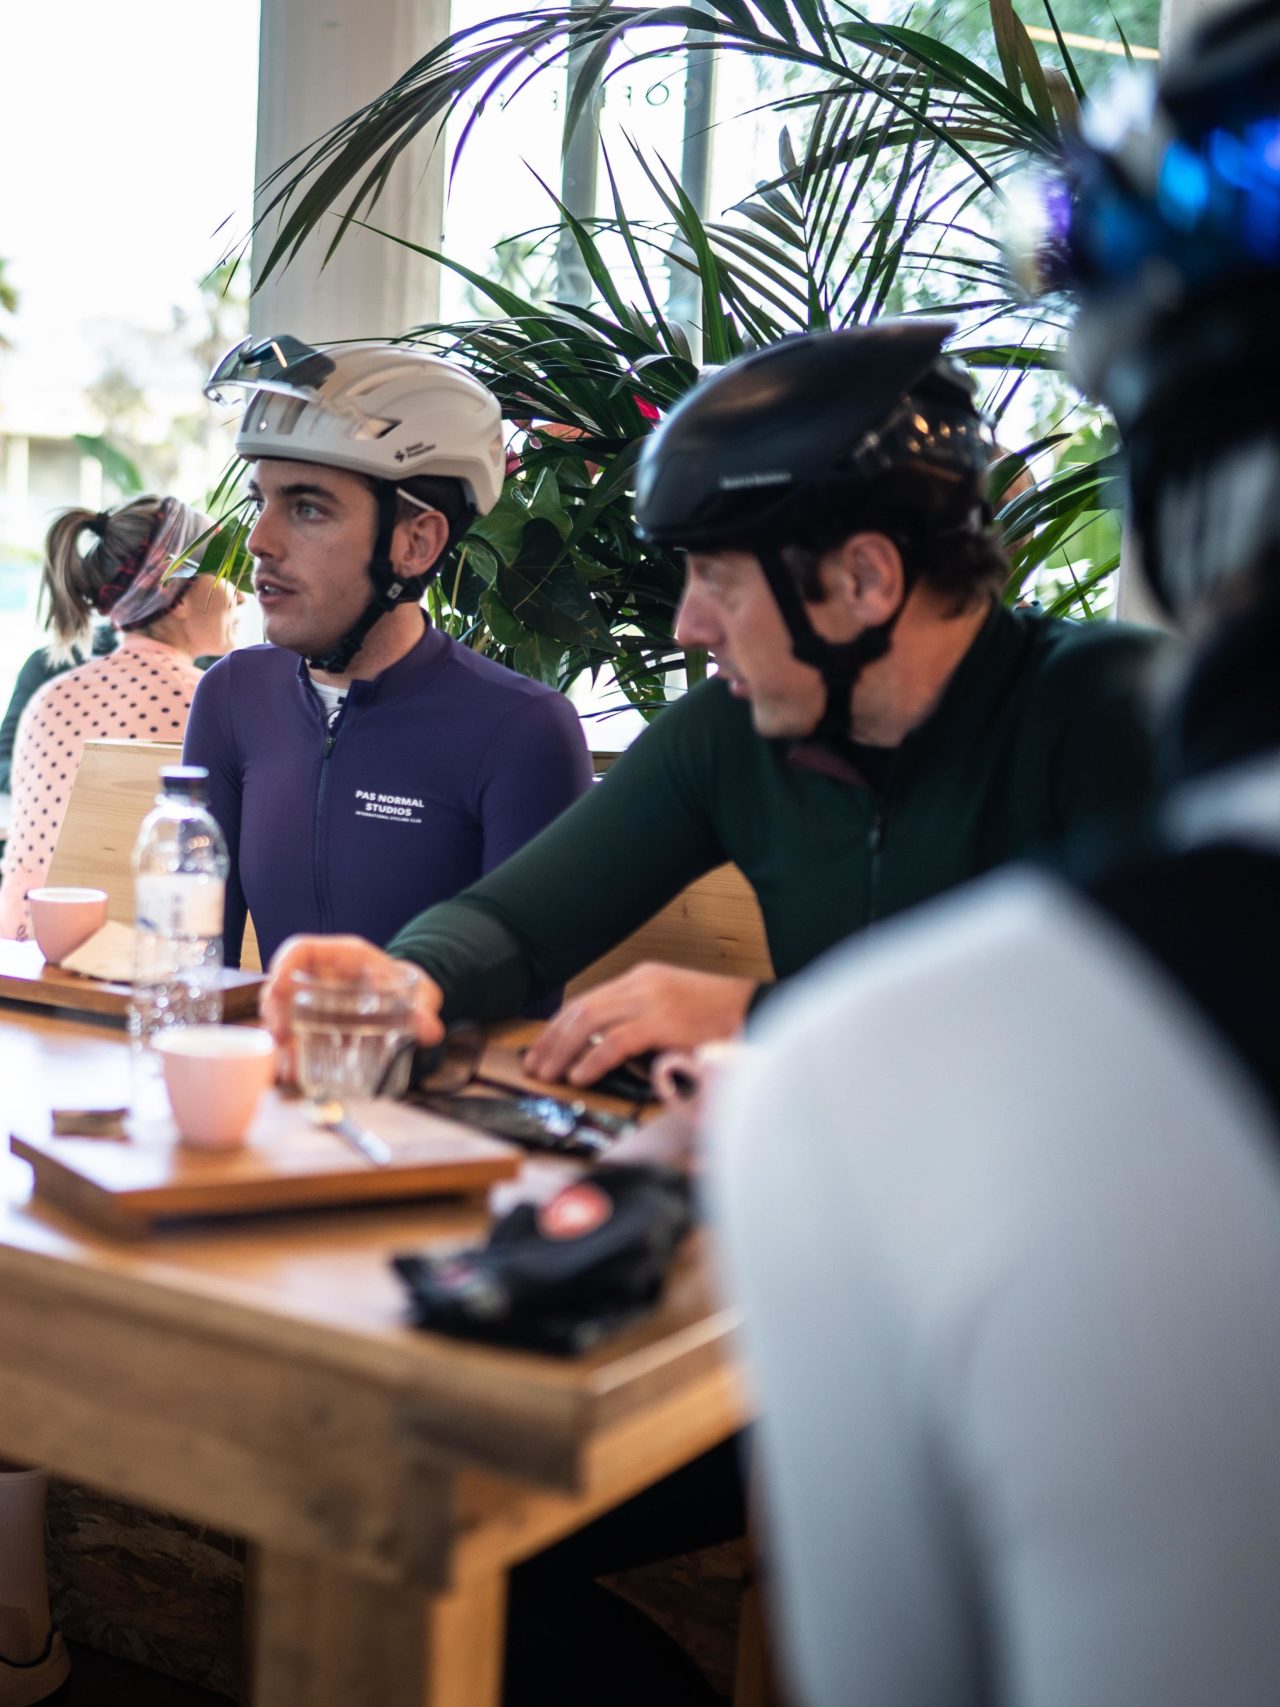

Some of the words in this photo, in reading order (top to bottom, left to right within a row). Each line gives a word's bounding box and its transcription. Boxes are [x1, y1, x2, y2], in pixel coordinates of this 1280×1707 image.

[355, 790, 376, 801] PAS
[378, 794, 424, 807] NORMAL
[365, 803, 411, 816] STUDIOS
